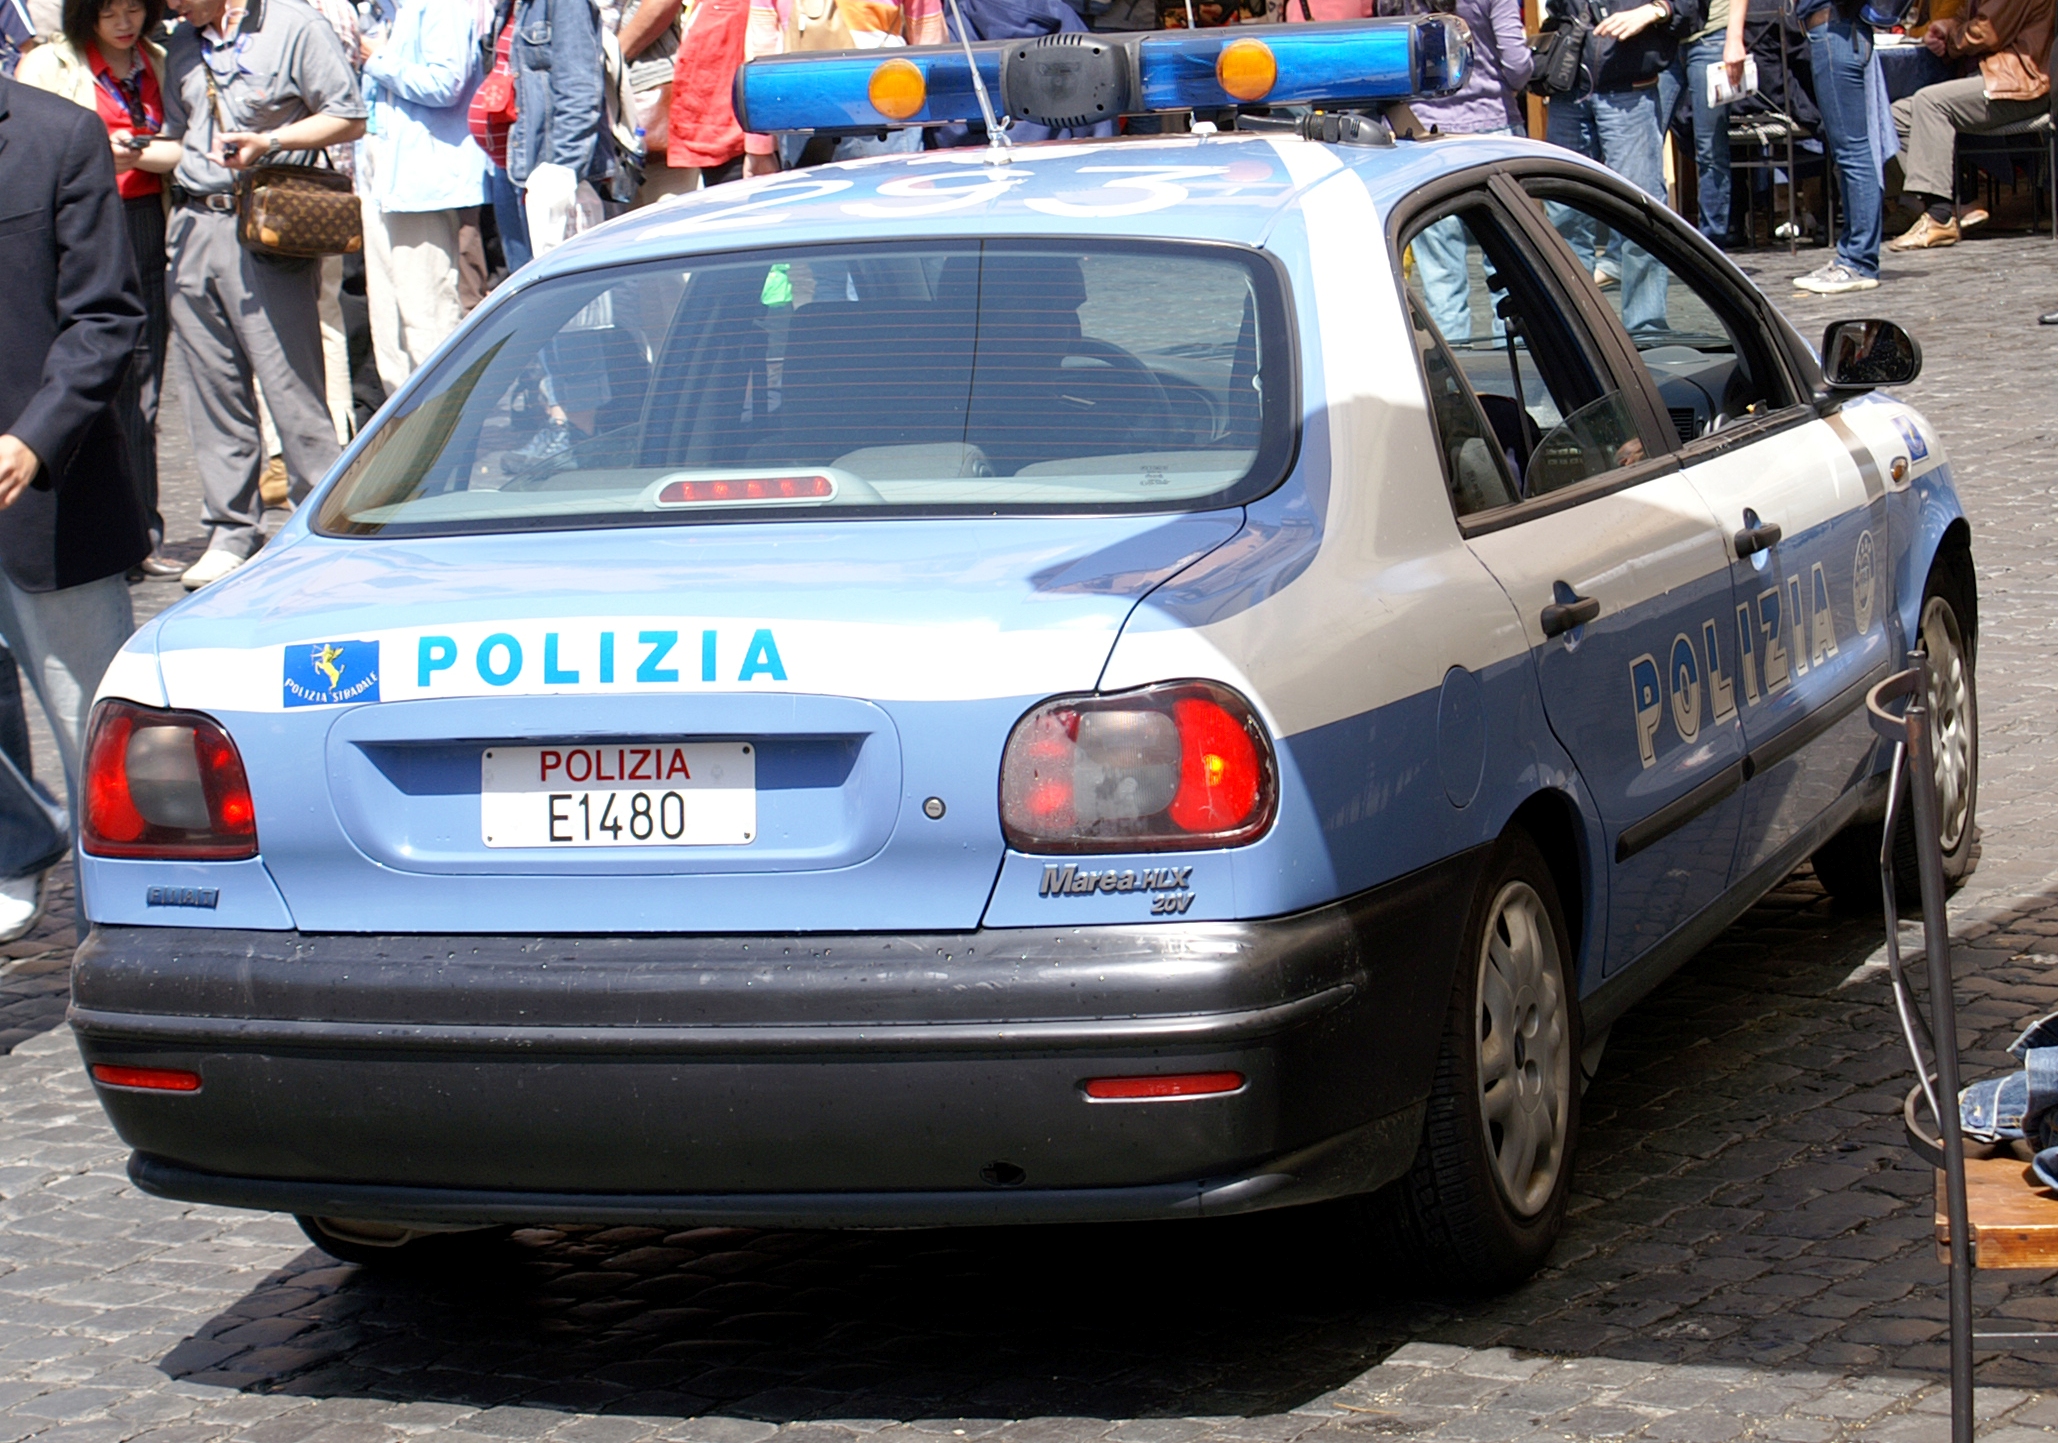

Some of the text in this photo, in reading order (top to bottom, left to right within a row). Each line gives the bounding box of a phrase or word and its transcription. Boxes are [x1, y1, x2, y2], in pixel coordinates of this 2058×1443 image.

[416, 628, 789, 688] POLIZIA
[1628, 560, 1840, 770] POLIZIA
[284, 670, 379, 703] POLIZIA STRADALE
[539, 747, 692, 783] POLIZIA
[548, 790, 686, 843] E1480
[149, 887, 215, 906] FIAT
[1038, 862, 1193, 899] Marea HLX
[1149, 891, 1196, 916] 20V
